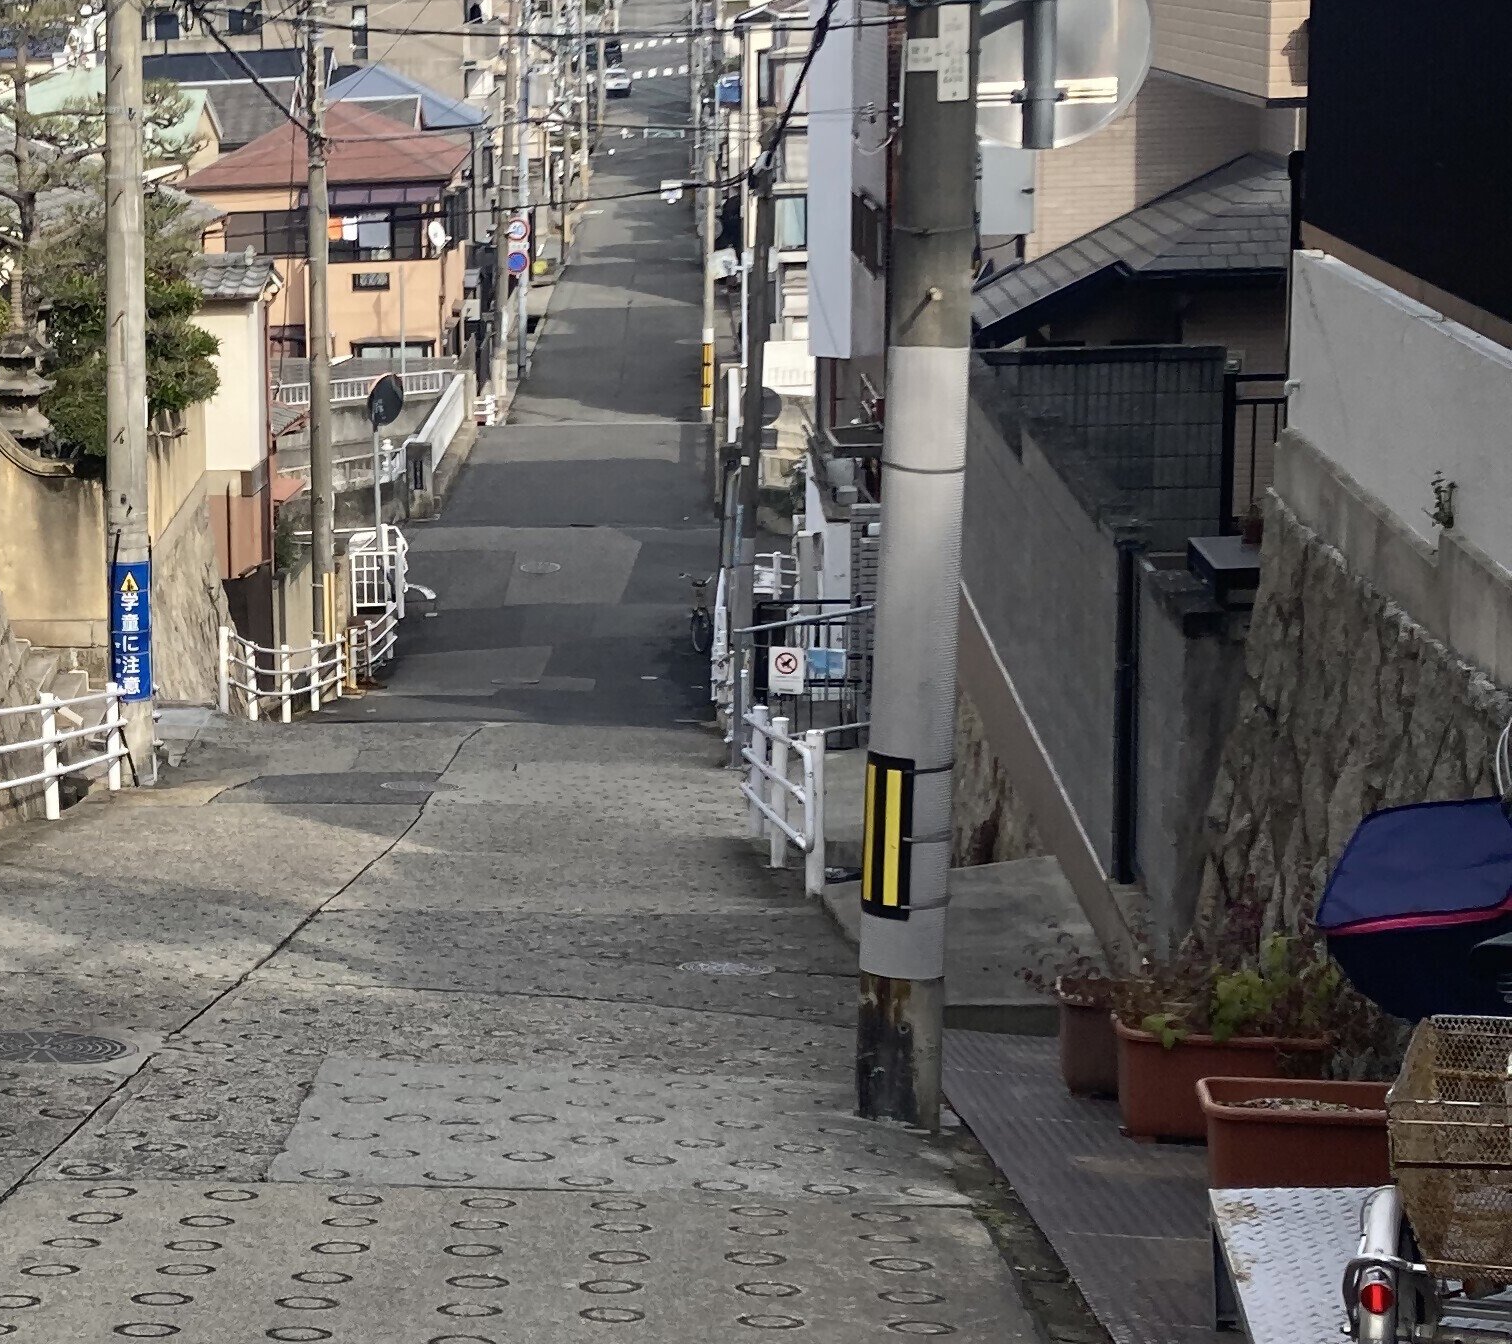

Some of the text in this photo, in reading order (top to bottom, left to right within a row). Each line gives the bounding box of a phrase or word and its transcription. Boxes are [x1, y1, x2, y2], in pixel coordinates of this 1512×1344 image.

[121, 591, 141, 695] 学童に注意
